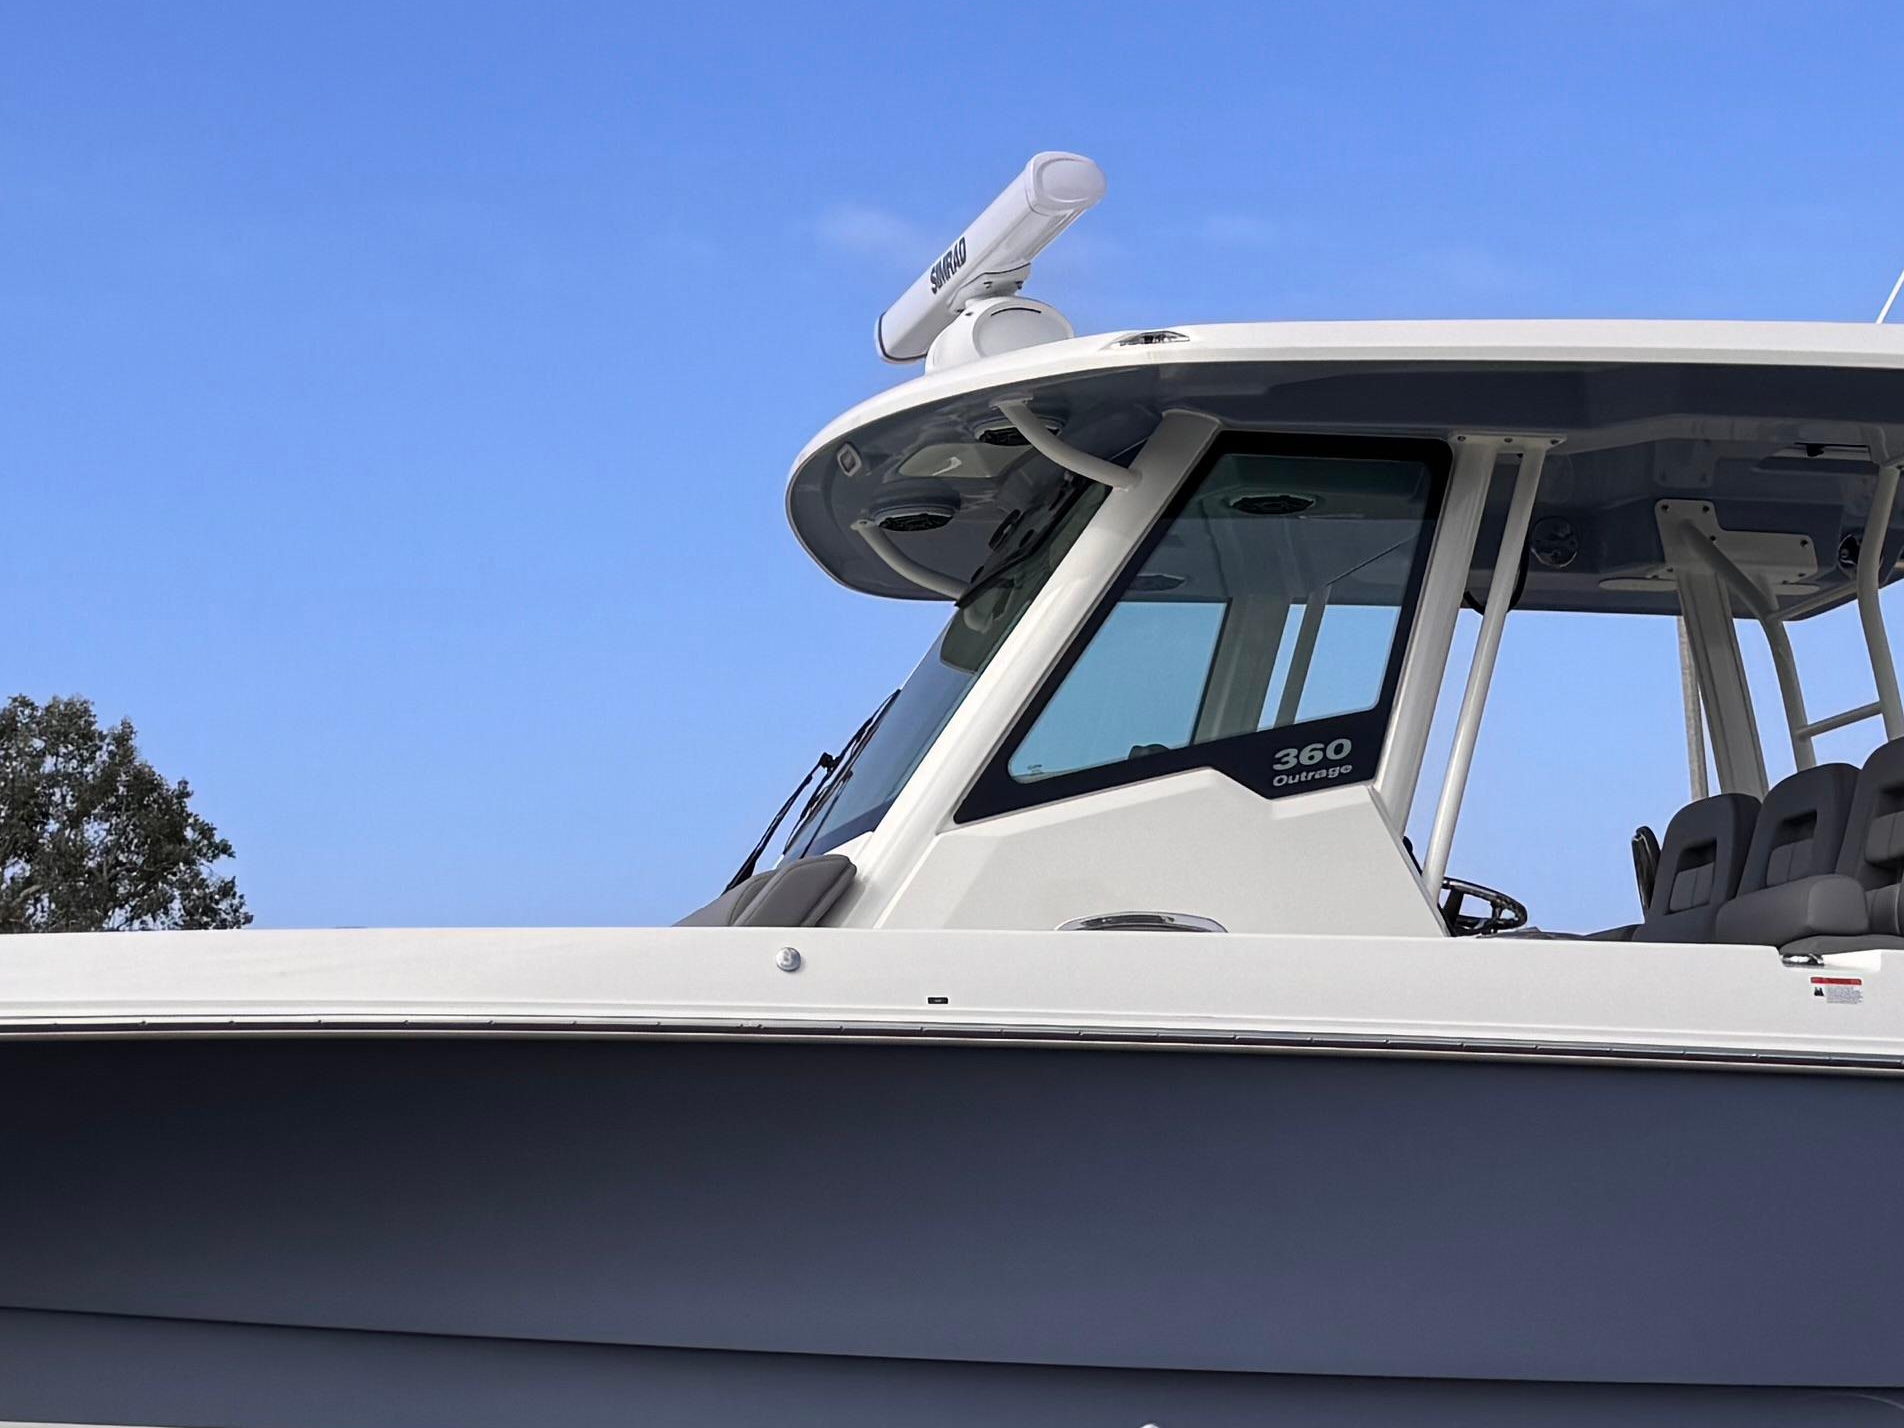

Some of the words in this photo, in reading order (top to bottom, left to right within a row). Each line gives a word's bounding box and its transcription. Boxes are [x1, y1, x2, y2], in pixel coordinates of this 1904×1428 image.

[930, 236, 967, 295] SIMRAD
[1272, 738, 1352, 771] 360
[1272, 764, 1353, 787] Outrage
